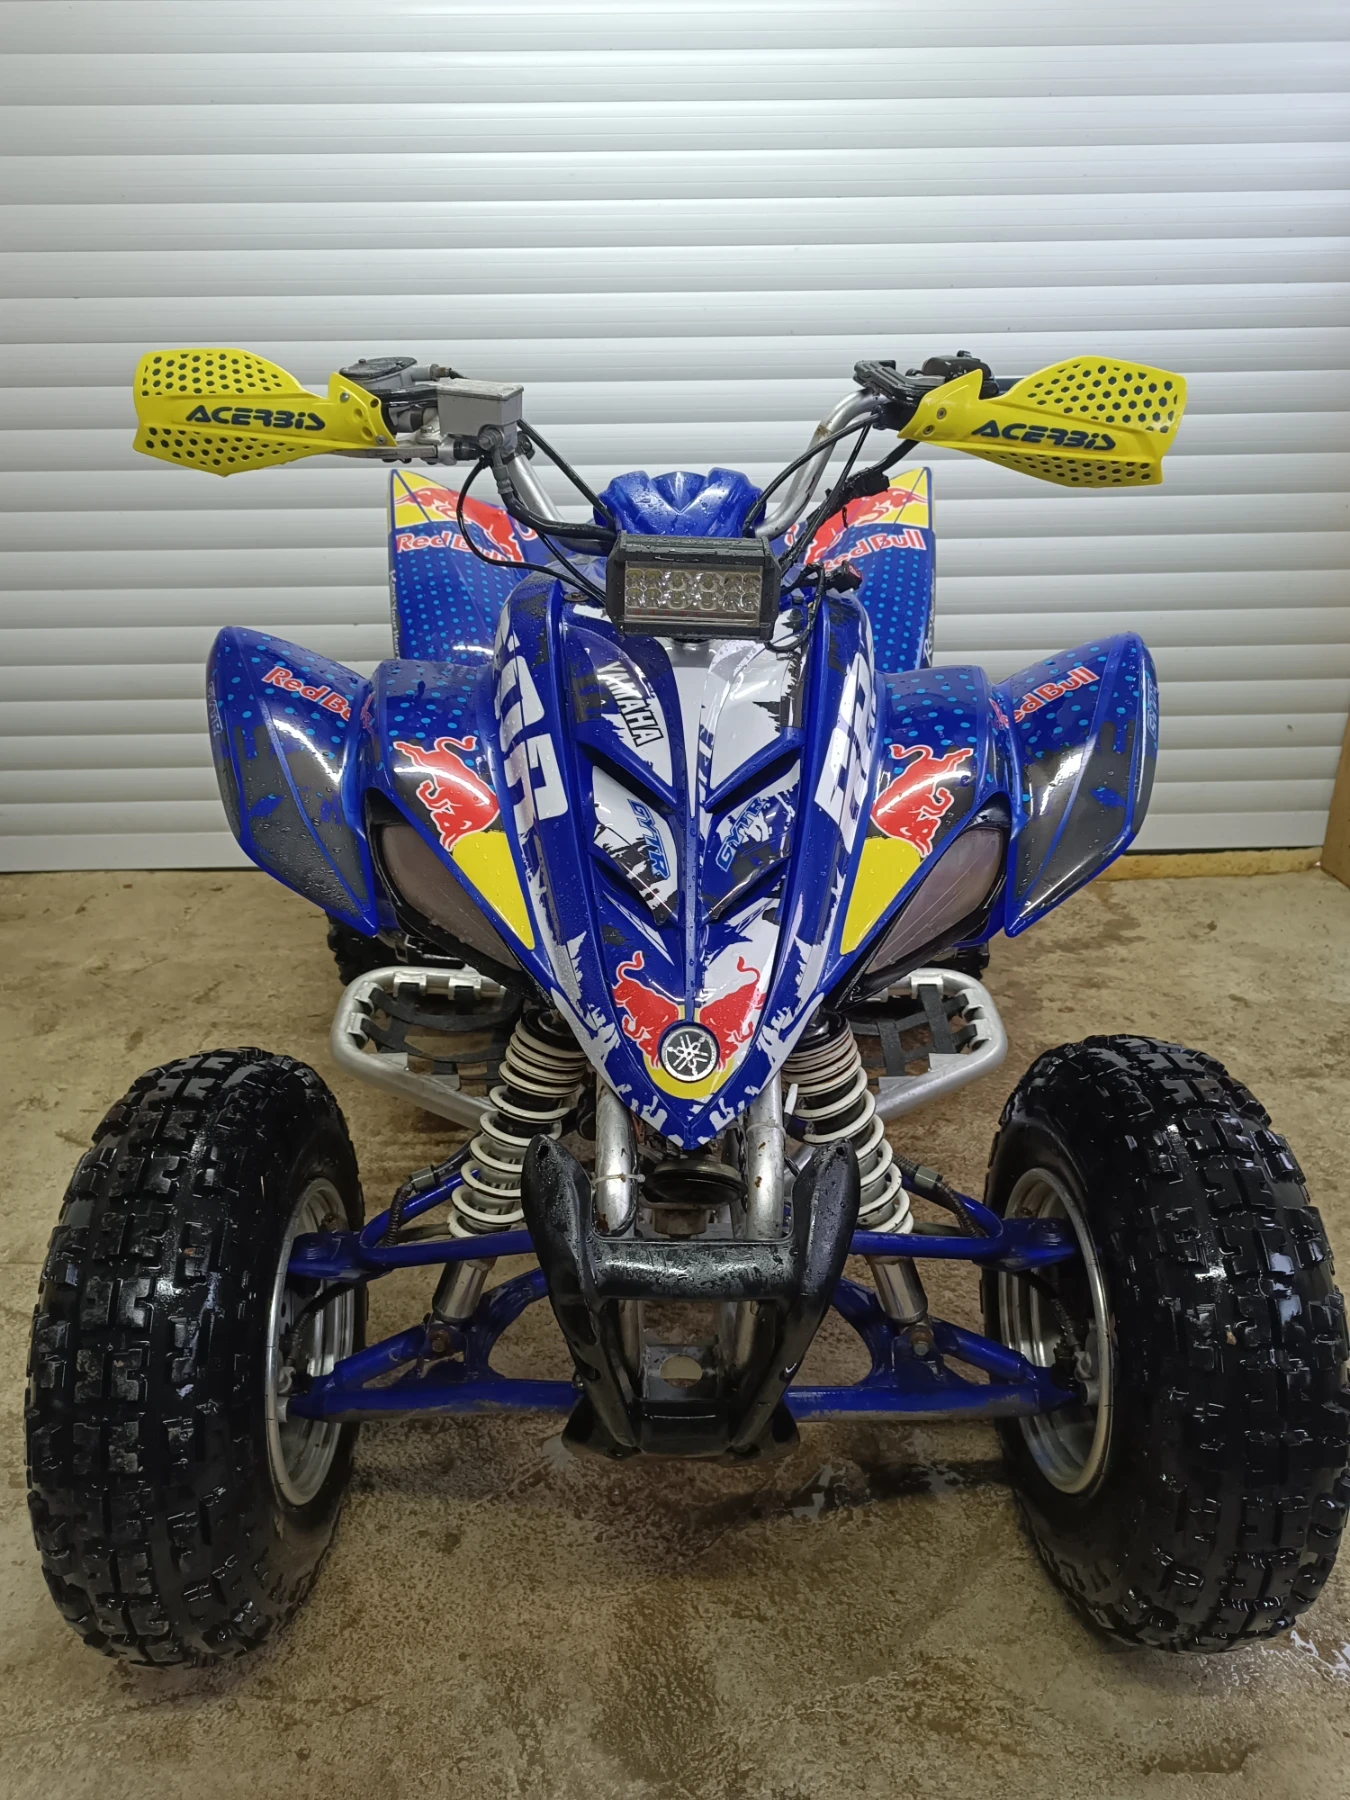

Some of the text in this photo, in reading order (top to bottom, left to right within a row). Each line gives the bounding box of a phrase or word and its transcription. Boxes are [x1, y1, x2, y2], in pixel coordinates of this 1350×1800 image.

[186, 404, 326, 431] ACERBIS
[971, 419, 1116, 451] ACERBIS
[396, 531, 452, 553] Red
[868, 528, 927, 551] Bull
[261, 666, 331, 702] Red
[1013, 666, 1101, 723] ed Bull
[596, 661, 664, 747] YAMAHA
[627, 798, 671, 880] GYTR
[715, 796, 766, 872] GYTR
